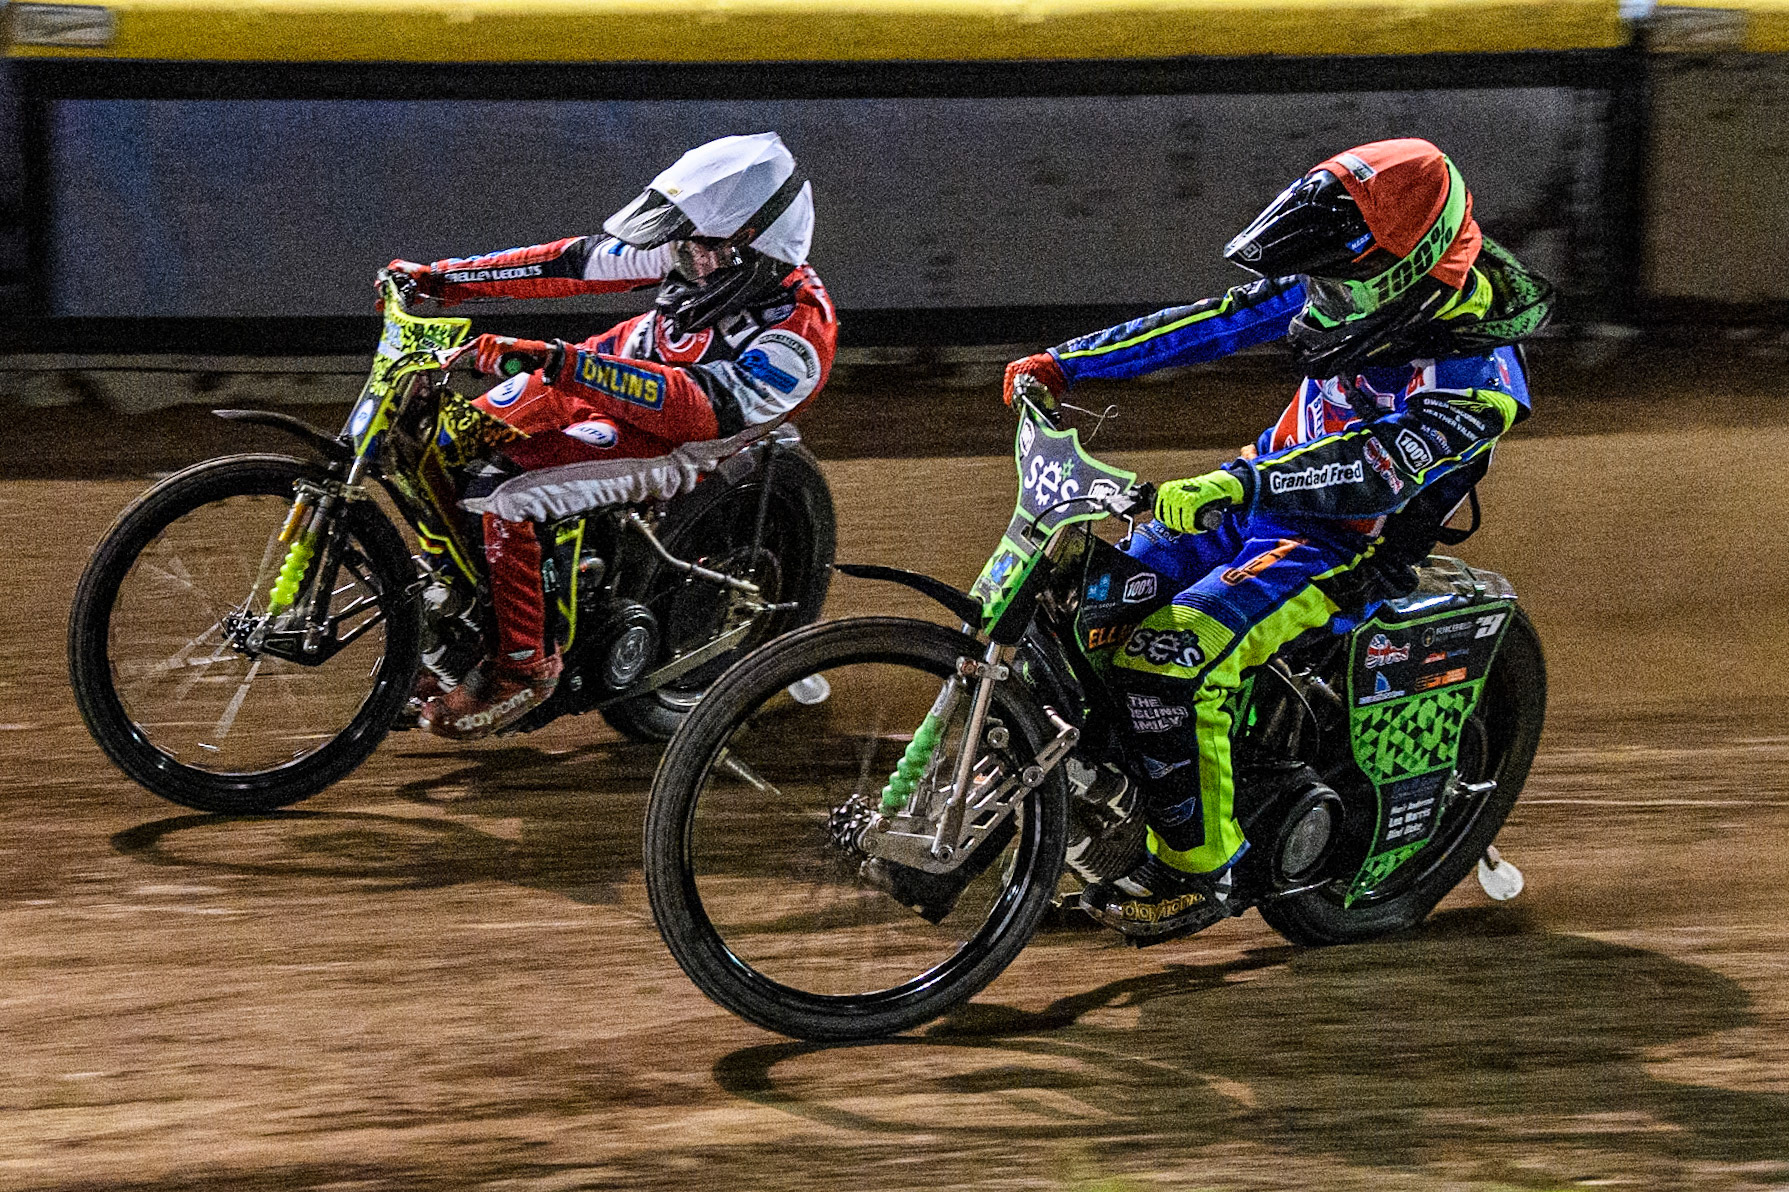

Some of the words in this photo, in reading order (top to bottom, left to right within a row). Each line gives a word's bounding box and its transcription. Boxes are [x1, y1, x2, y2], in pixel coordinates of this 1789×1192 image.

[1272, 466, 1329, 491] Grandad
[1331, 462, 1362, 482] Fred
[1128, 695, 1161, 708] THE
